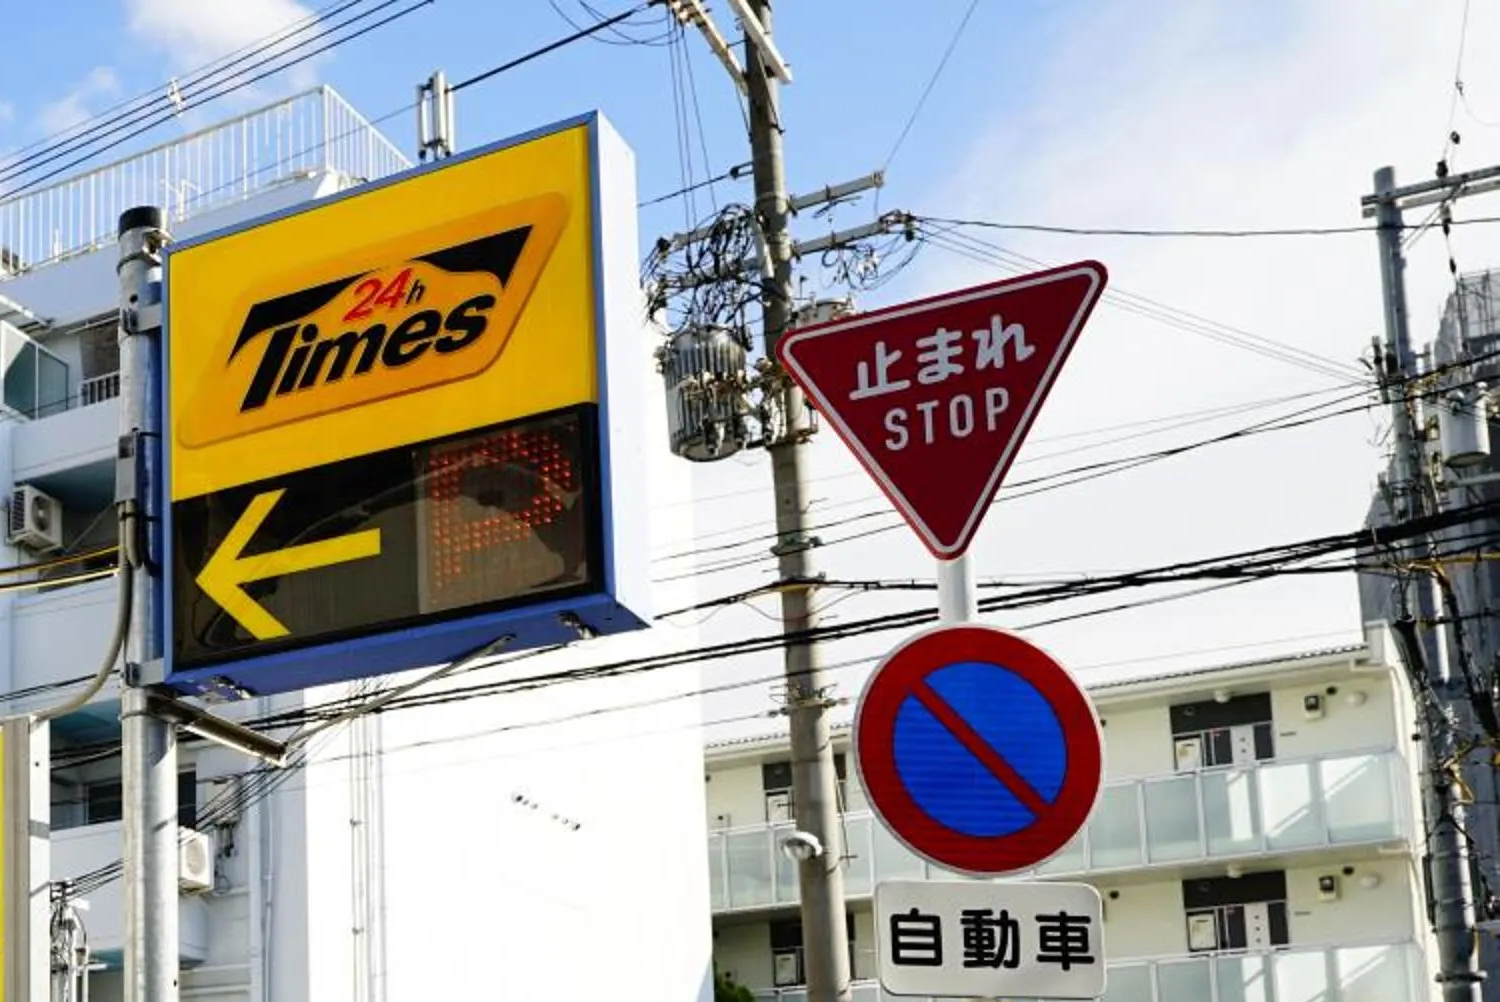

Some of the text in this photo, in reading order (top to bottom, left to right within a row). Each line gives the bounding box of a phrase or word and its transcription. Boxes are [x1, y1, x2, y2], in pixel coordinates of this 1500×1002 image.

[342, 267, 425, 321] 24h
[228, 292, 498, 413] Times
[849, 314, 1035, 400] 止まれ
[884, 387, 1009, 450] STOP
[890, 908, 1095, 971] 自動車
